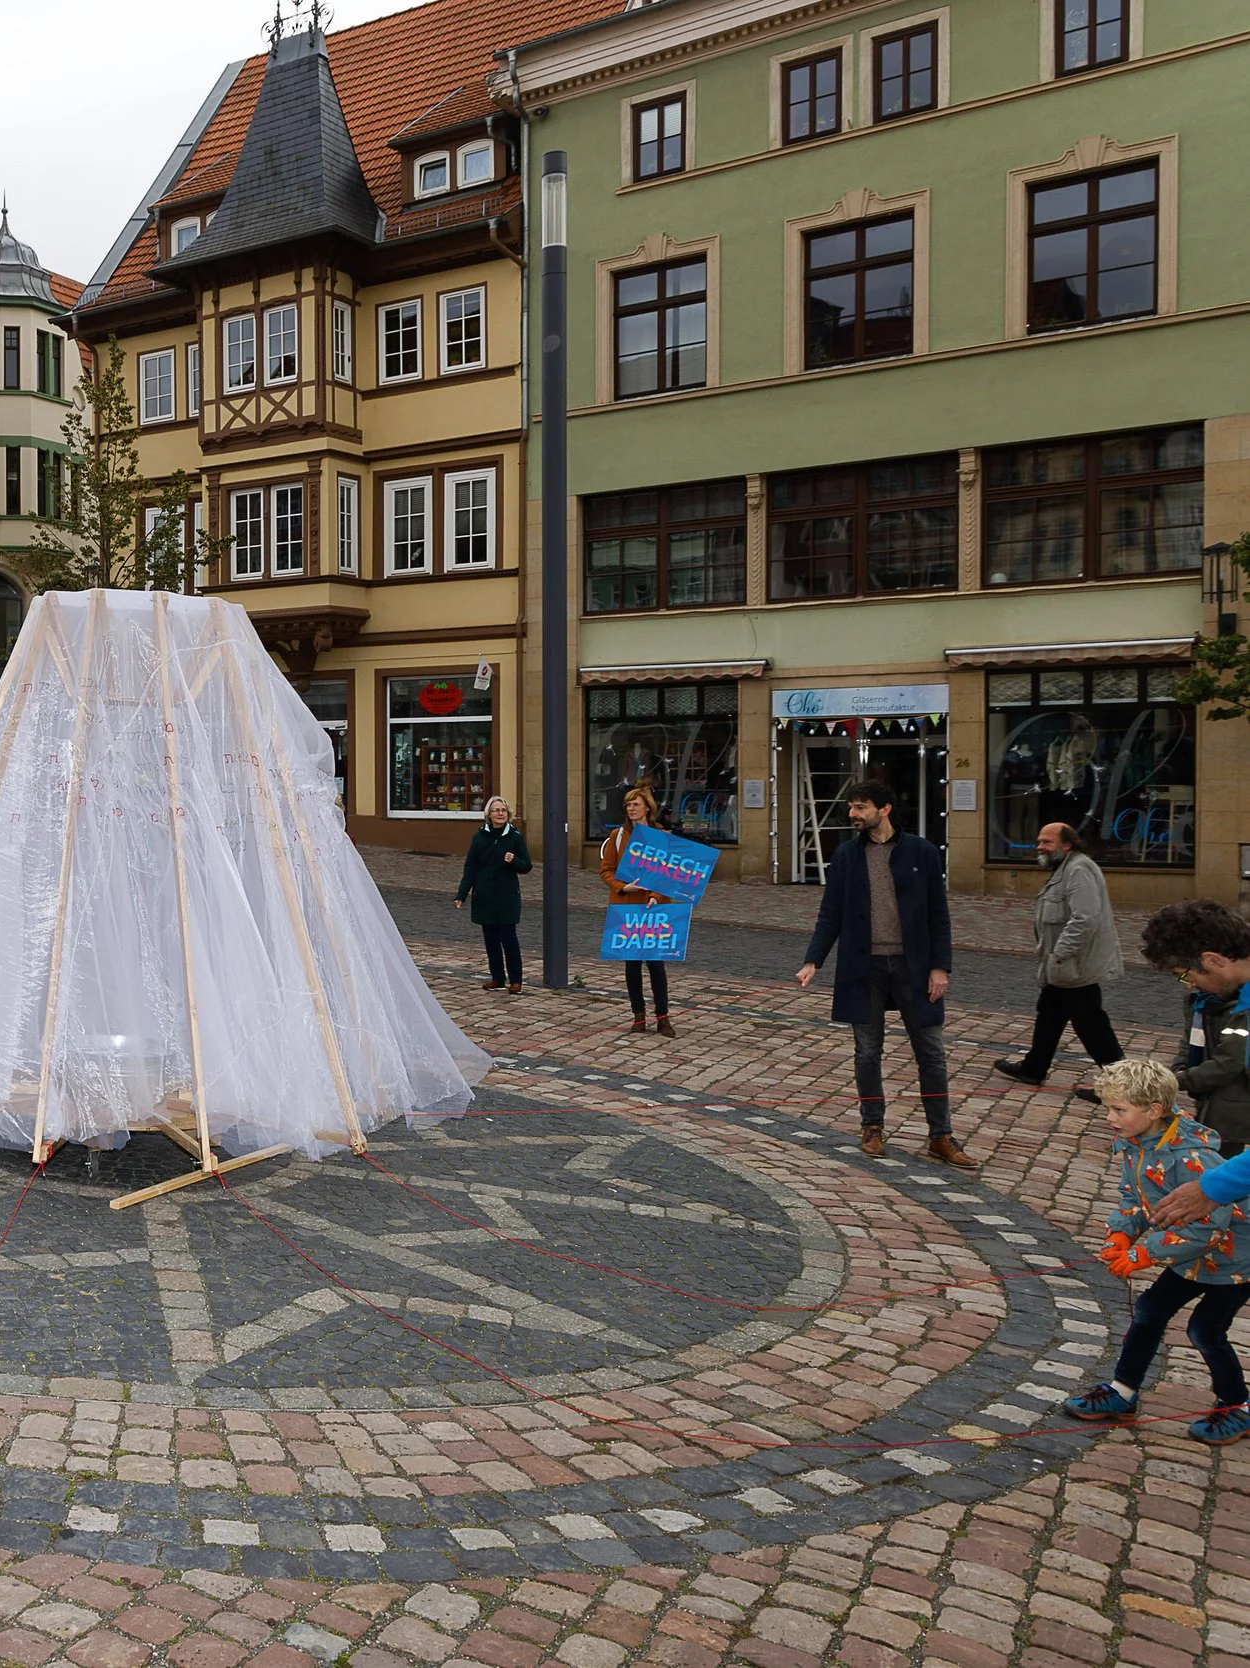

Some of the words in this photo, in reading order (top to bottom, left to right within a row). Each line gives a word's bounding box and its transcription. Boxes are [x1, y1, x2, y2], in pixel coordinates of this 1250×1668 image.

[851, 695, 889, 705] Gläserne
[851, 704, 917, 714] Nähmanufaktur
[955, 758, 971, 768] 24
[628, 841, 710, 879] GERECH
[628, 849, 707, 887] TIGKEIT
[625, 912, 669, 928] WIR
[618, 923, 673, 939] SIND
[611, 933, 678, 949] DABEI
